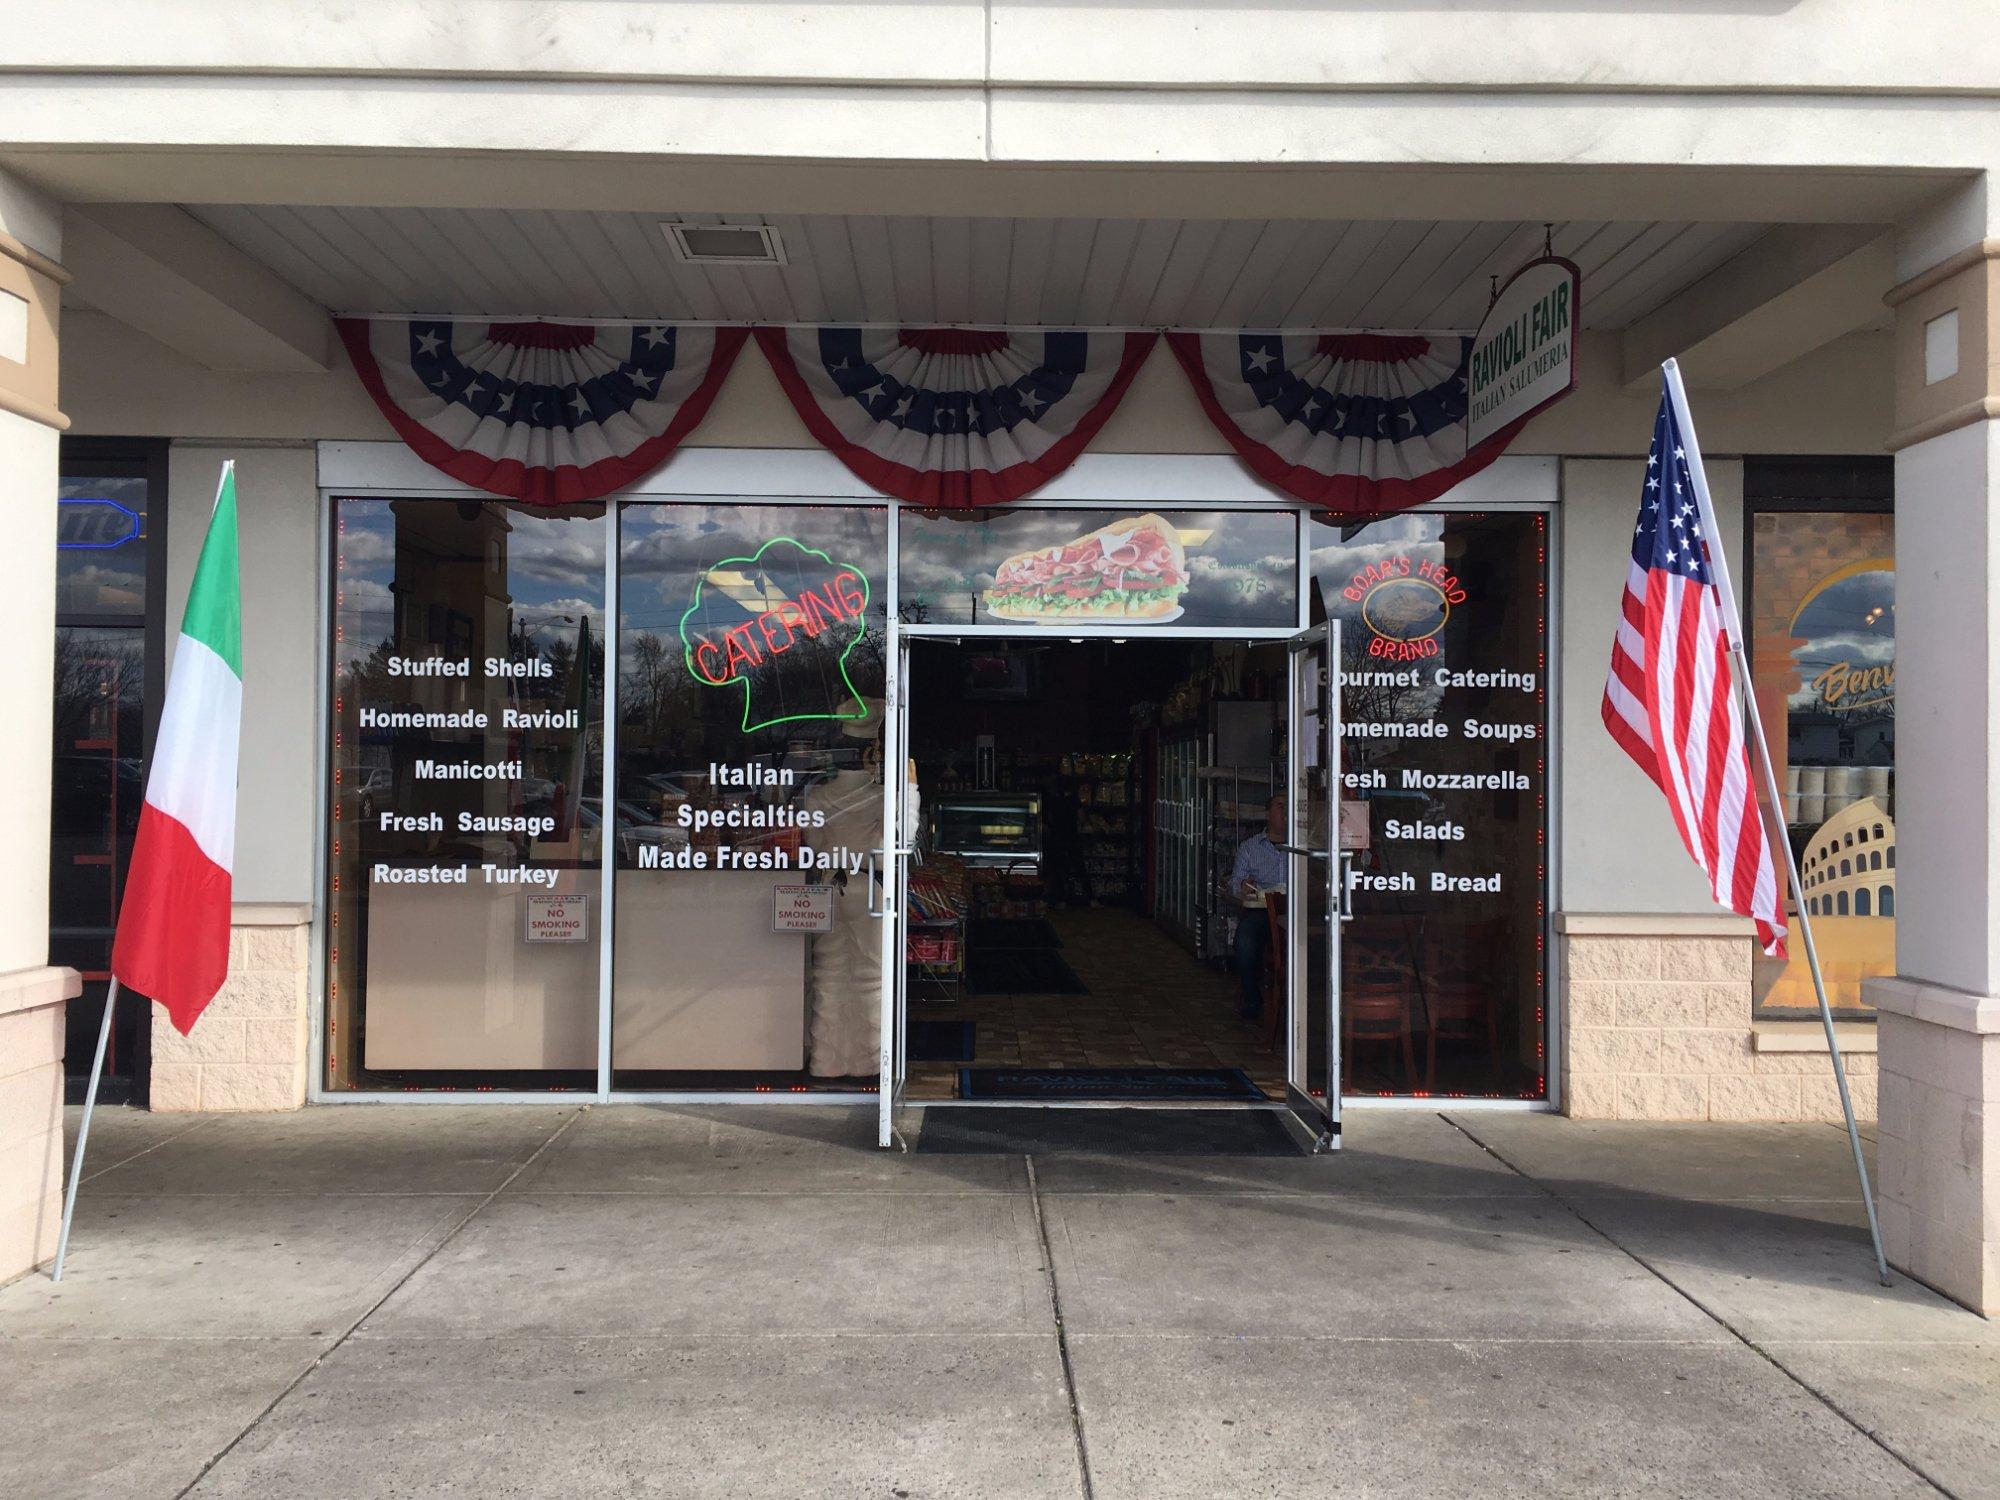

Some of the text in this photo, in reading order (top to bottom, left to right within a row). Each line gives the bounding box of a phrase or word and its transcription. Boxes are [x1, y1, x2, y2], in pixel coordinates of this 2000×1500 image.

[1472, 280, 1569, 397] RAVIOLI FAIR
[1472, 341, 1569, 424] ITALIAN SALUMERIA
[1343, 556, 1467, 604] BOAR'S HEAD
[697, 571, 867, 684] CATERING
[1368, 637, 1439, 662] BRAND
[387, 656, 554, 678] Stuffed Shells
[1434, 668, 1536, 693] Catering
[359, 708, 579, 729] Homemade Ravioli
[1463, 718, 1537, 744] Soups
[415, 759, 522, 780] Manicotti
[709, 762, 794, 786] Italian
[1402, 769, 1530, 790] Mozzarella
[380, 811, 556, 837] Fresh Sausage
[677, 803, 827, 833] Specialties
[1384, 819, 1466, 841] Salads
[638, 844, 864, 876] Made Fresh Daily
[373, 863, 560, 889] Roasted Turkey
[1349, 871, 1502, 892] Fresh Bread
[547, 909, 565, 918] NO
[778, 911, 826, 920] SMOKING
[794, 900, 811, 908] NO
[531, 920, 580, 929] SMOKING
